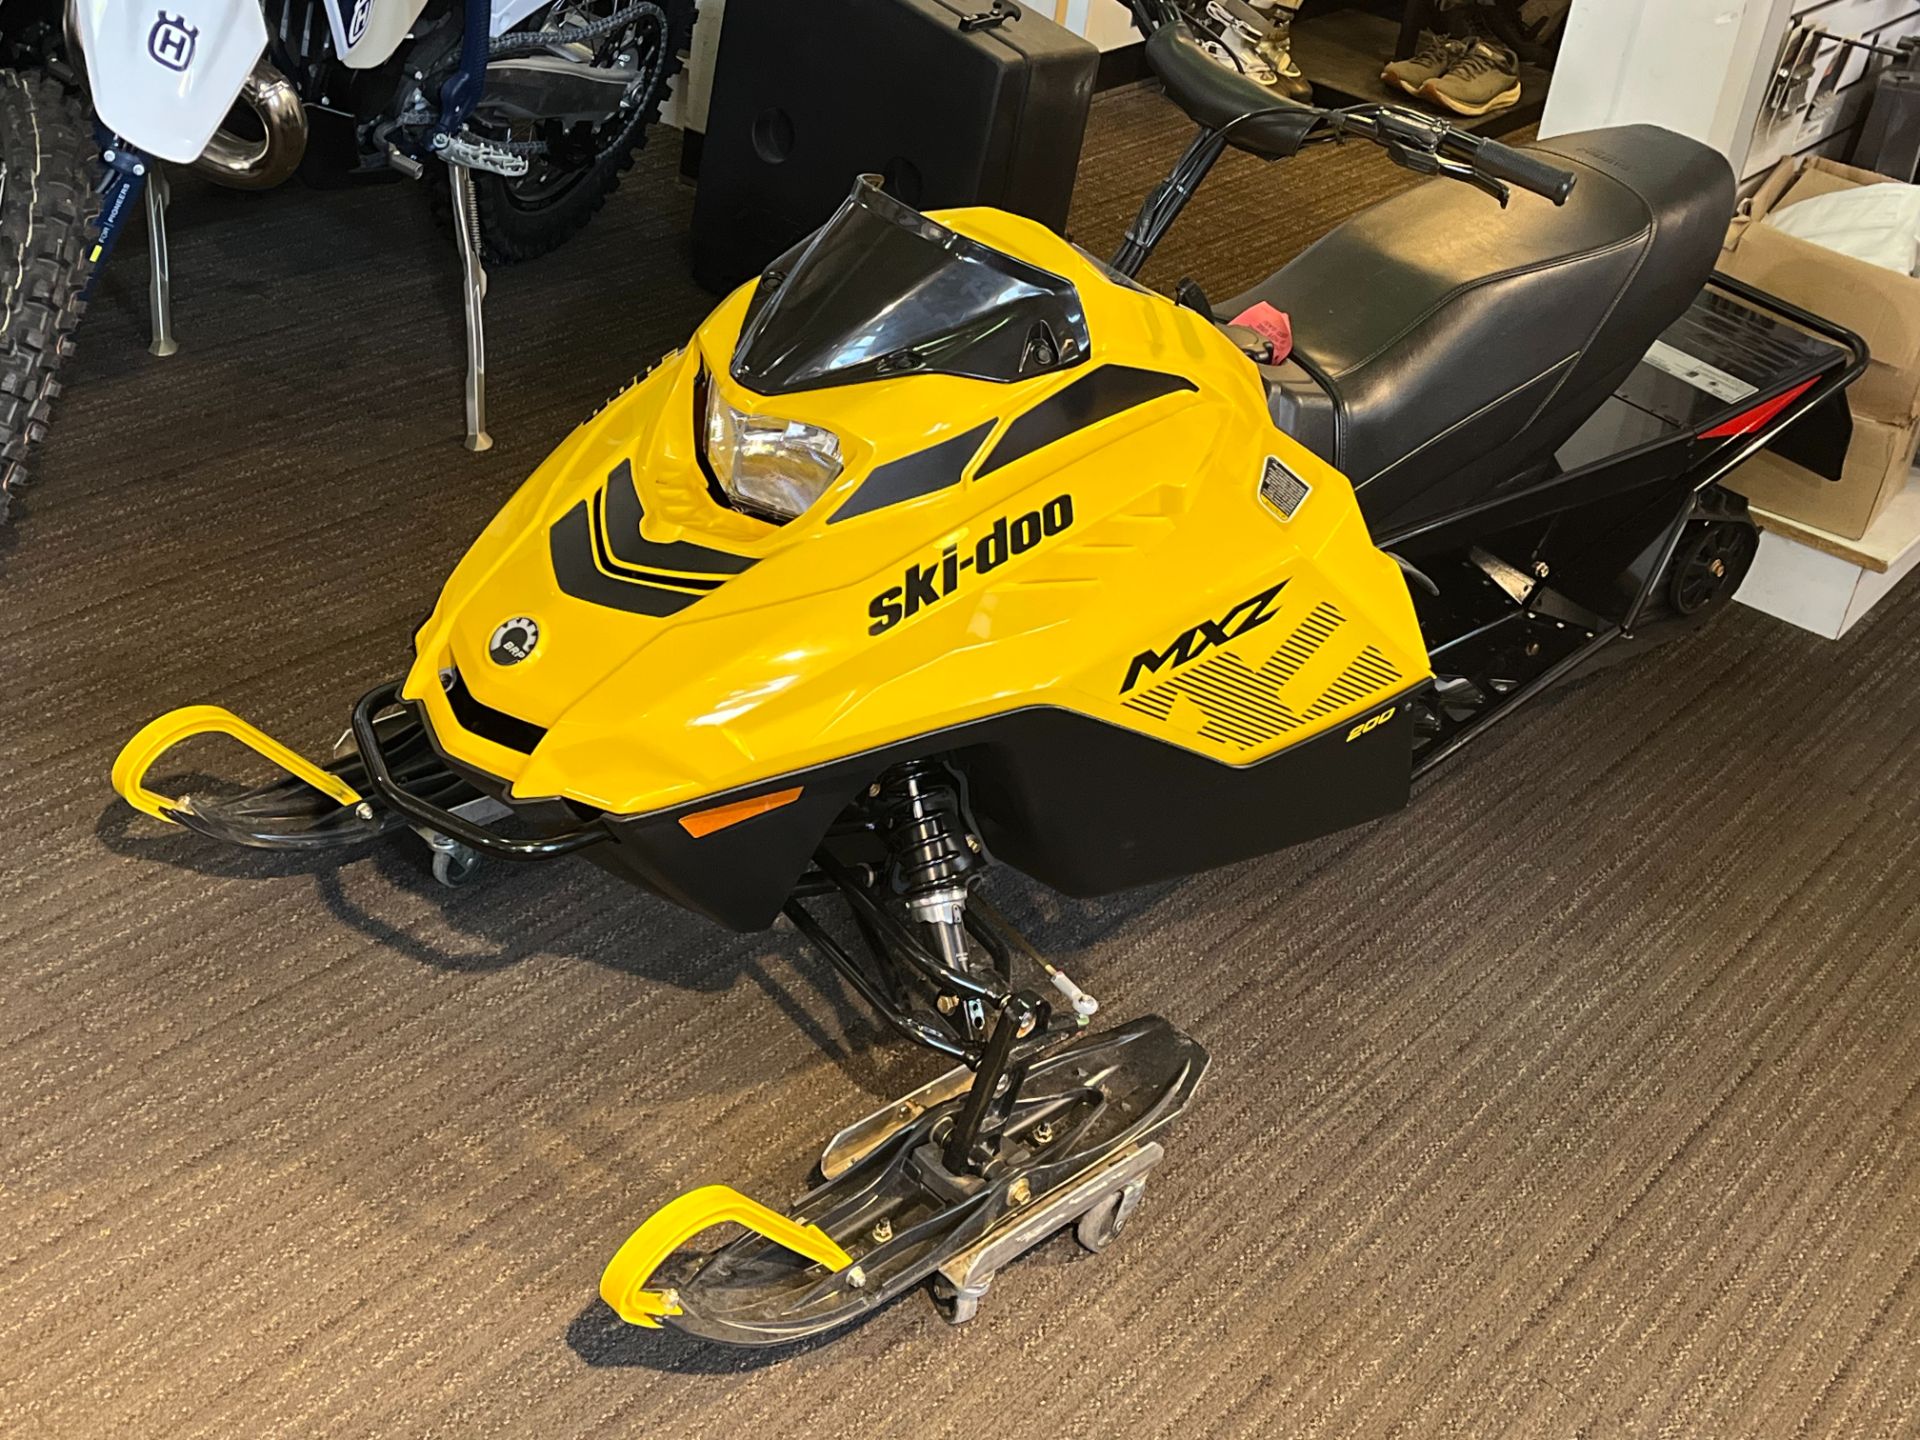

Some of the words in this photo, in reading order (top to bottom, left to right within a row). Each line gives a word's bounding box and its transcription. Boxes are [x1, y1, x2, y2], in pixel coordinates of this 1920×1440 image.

[98, 227, 110, 243] FOR
[108, 183, 130, 223] PIONEERS
[868, 494, 1074, 637] ski-doo
[502, 641, 526, 658] BRP
[1119, 576, 1294, 695] MXZ
[1346, 707, 1396, 742] 200
